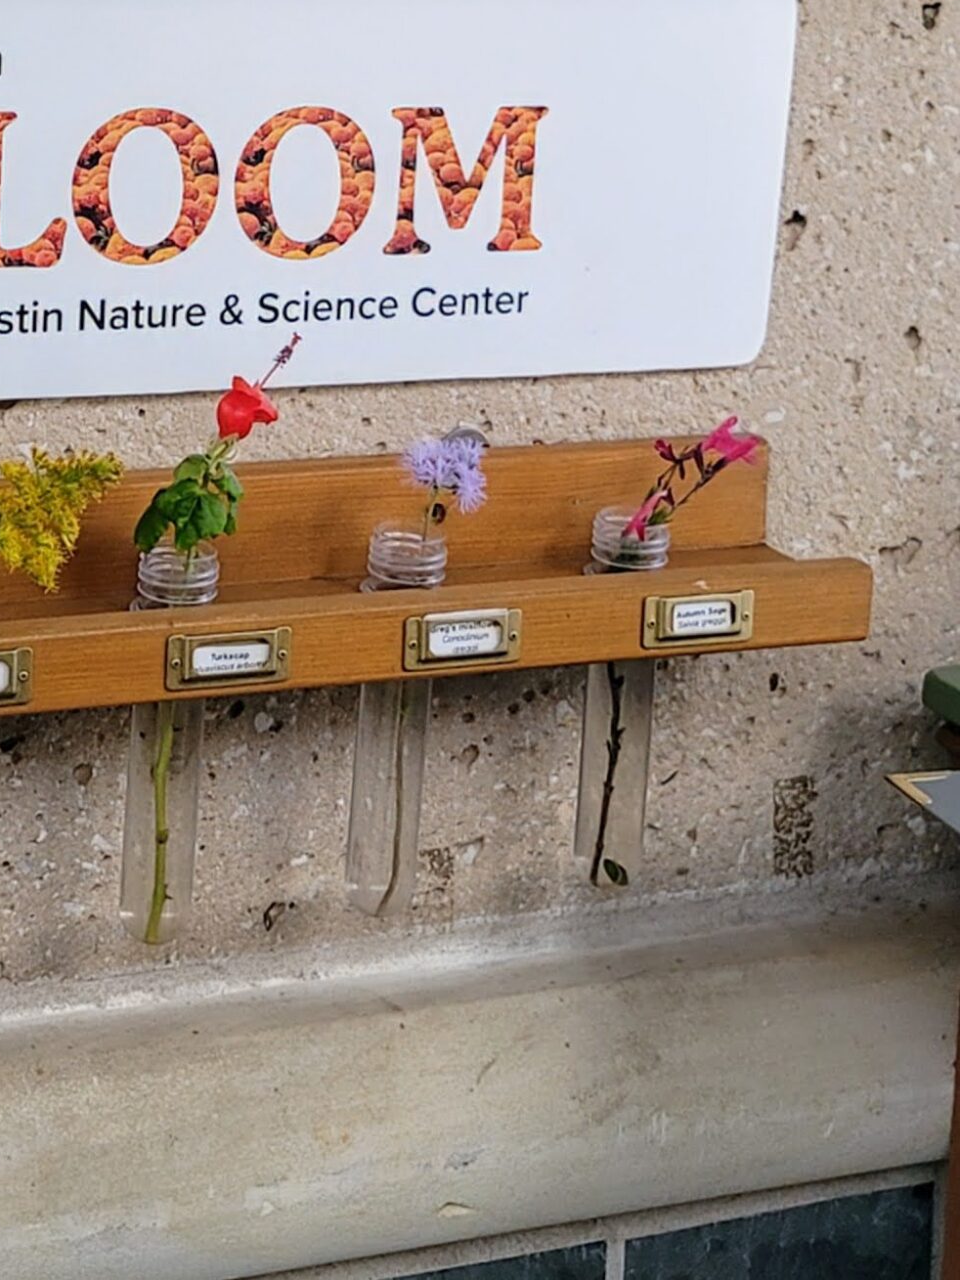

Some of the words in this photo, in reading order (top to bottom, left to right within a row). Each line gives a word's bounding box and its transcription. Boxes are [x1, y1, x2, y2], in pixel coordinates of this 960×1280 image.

[78, 295, 207, 333] Nature
[219, 294, 244, 325] &
[257, 288, 399, 324] Science
[412, 287, 529, 318] Center
